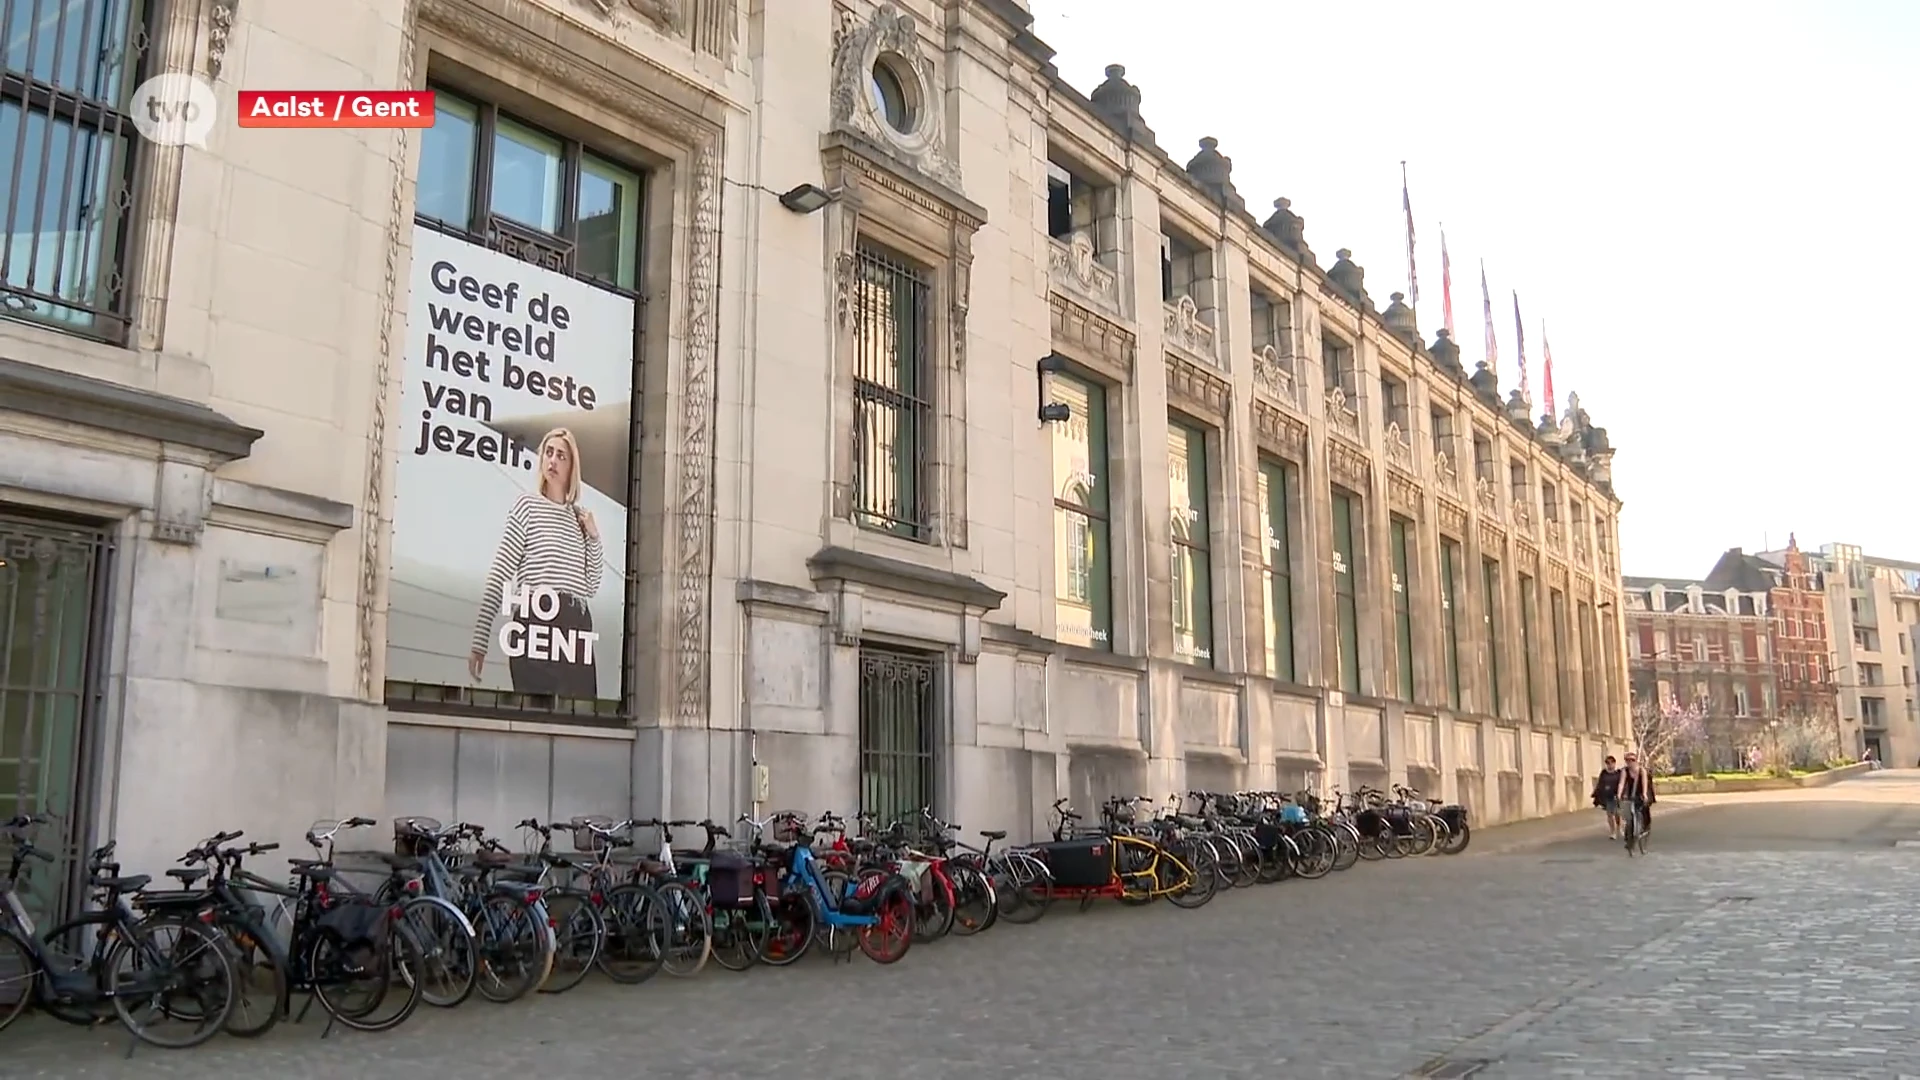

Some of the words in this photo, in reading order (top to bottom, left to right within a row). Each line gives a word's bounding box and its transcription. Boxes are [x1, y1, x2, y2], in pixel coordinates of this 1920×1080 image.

[431, 261, 519, 313] Geef
[528, 293, 570, 330] de
[428, 303, 555, 362] wereld
[423, 381, 492, 422] van
[426, 333, 490, 383] het
[503, 355, 596, 411] beste
[415, 410, 532, 470] jezelf.
[501, 581, 560, 621] HO
[499, 621, 599, 665] GENT
